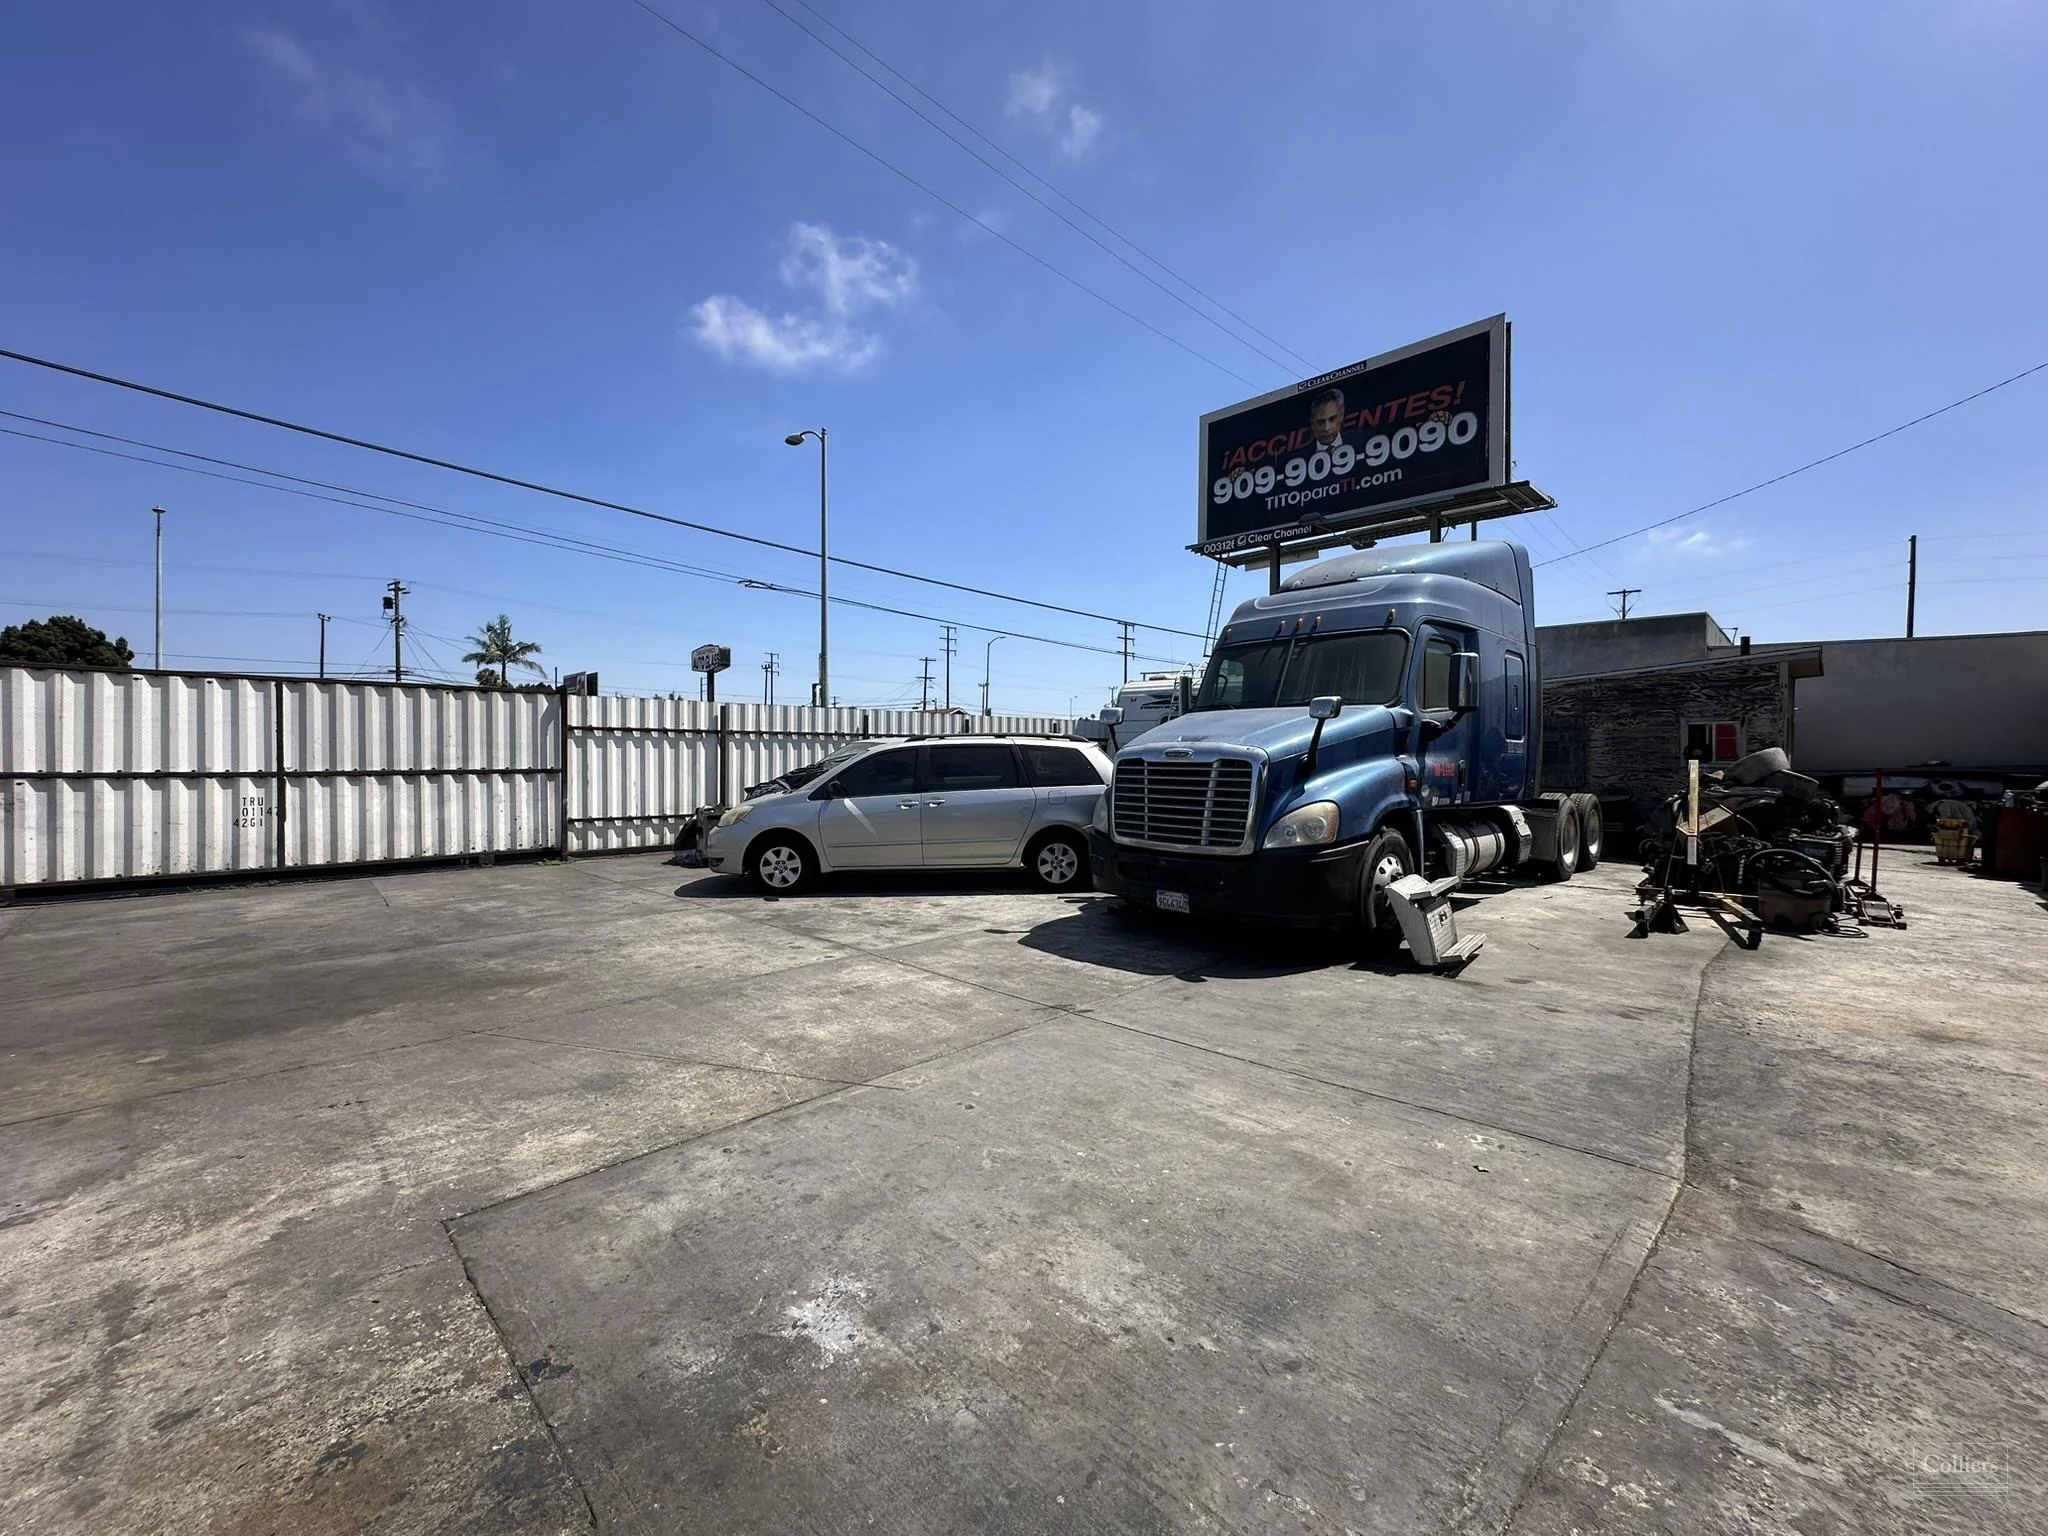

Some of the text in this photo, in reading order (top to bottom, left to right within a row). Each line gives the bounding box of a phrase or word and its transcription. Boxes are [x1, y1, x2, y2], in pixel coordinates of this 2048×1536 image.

[1213, 411, 1478, 504] 909-909-9090
[1247, 533, 1272, 545] Clear
[1273, 525, 1312, 540] Channel
